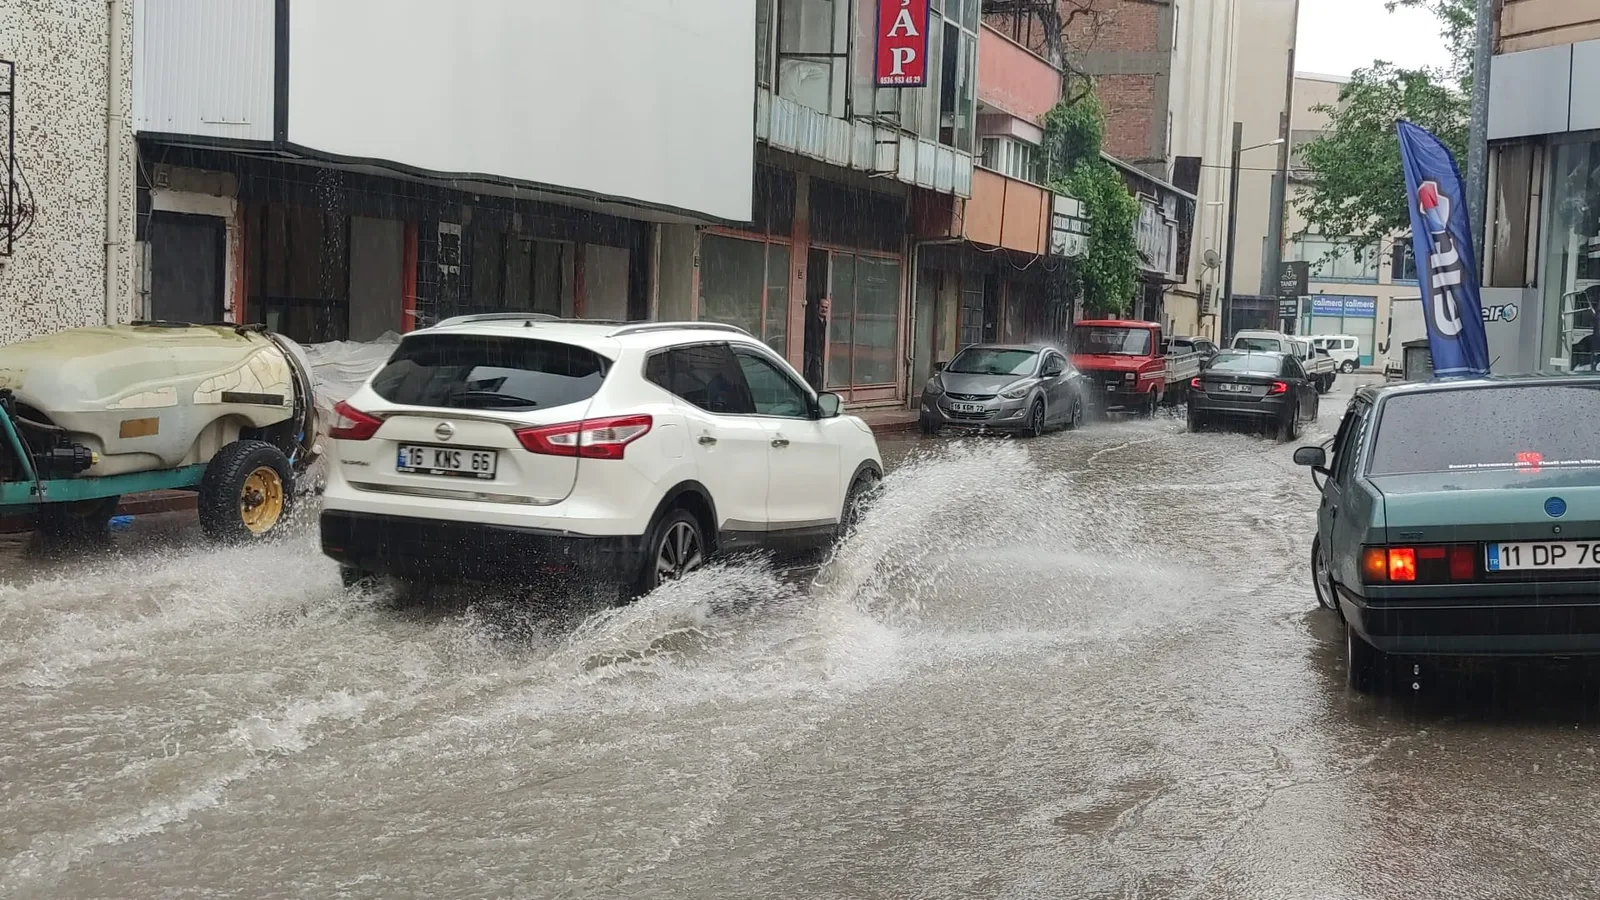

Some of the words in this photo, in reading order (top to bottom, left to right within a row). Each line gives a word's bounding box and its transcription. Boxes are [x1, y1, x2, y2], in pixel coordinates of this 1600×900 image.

[409, 448, 424, 466] 16
[434, 449, 461, 469] KNS
[472, 452, 489, 471] 66
[1502, 545, 1520, 567] 11
[1532, 544, 1567, 566] DP
[1576, 543, 1600, 564] 76
